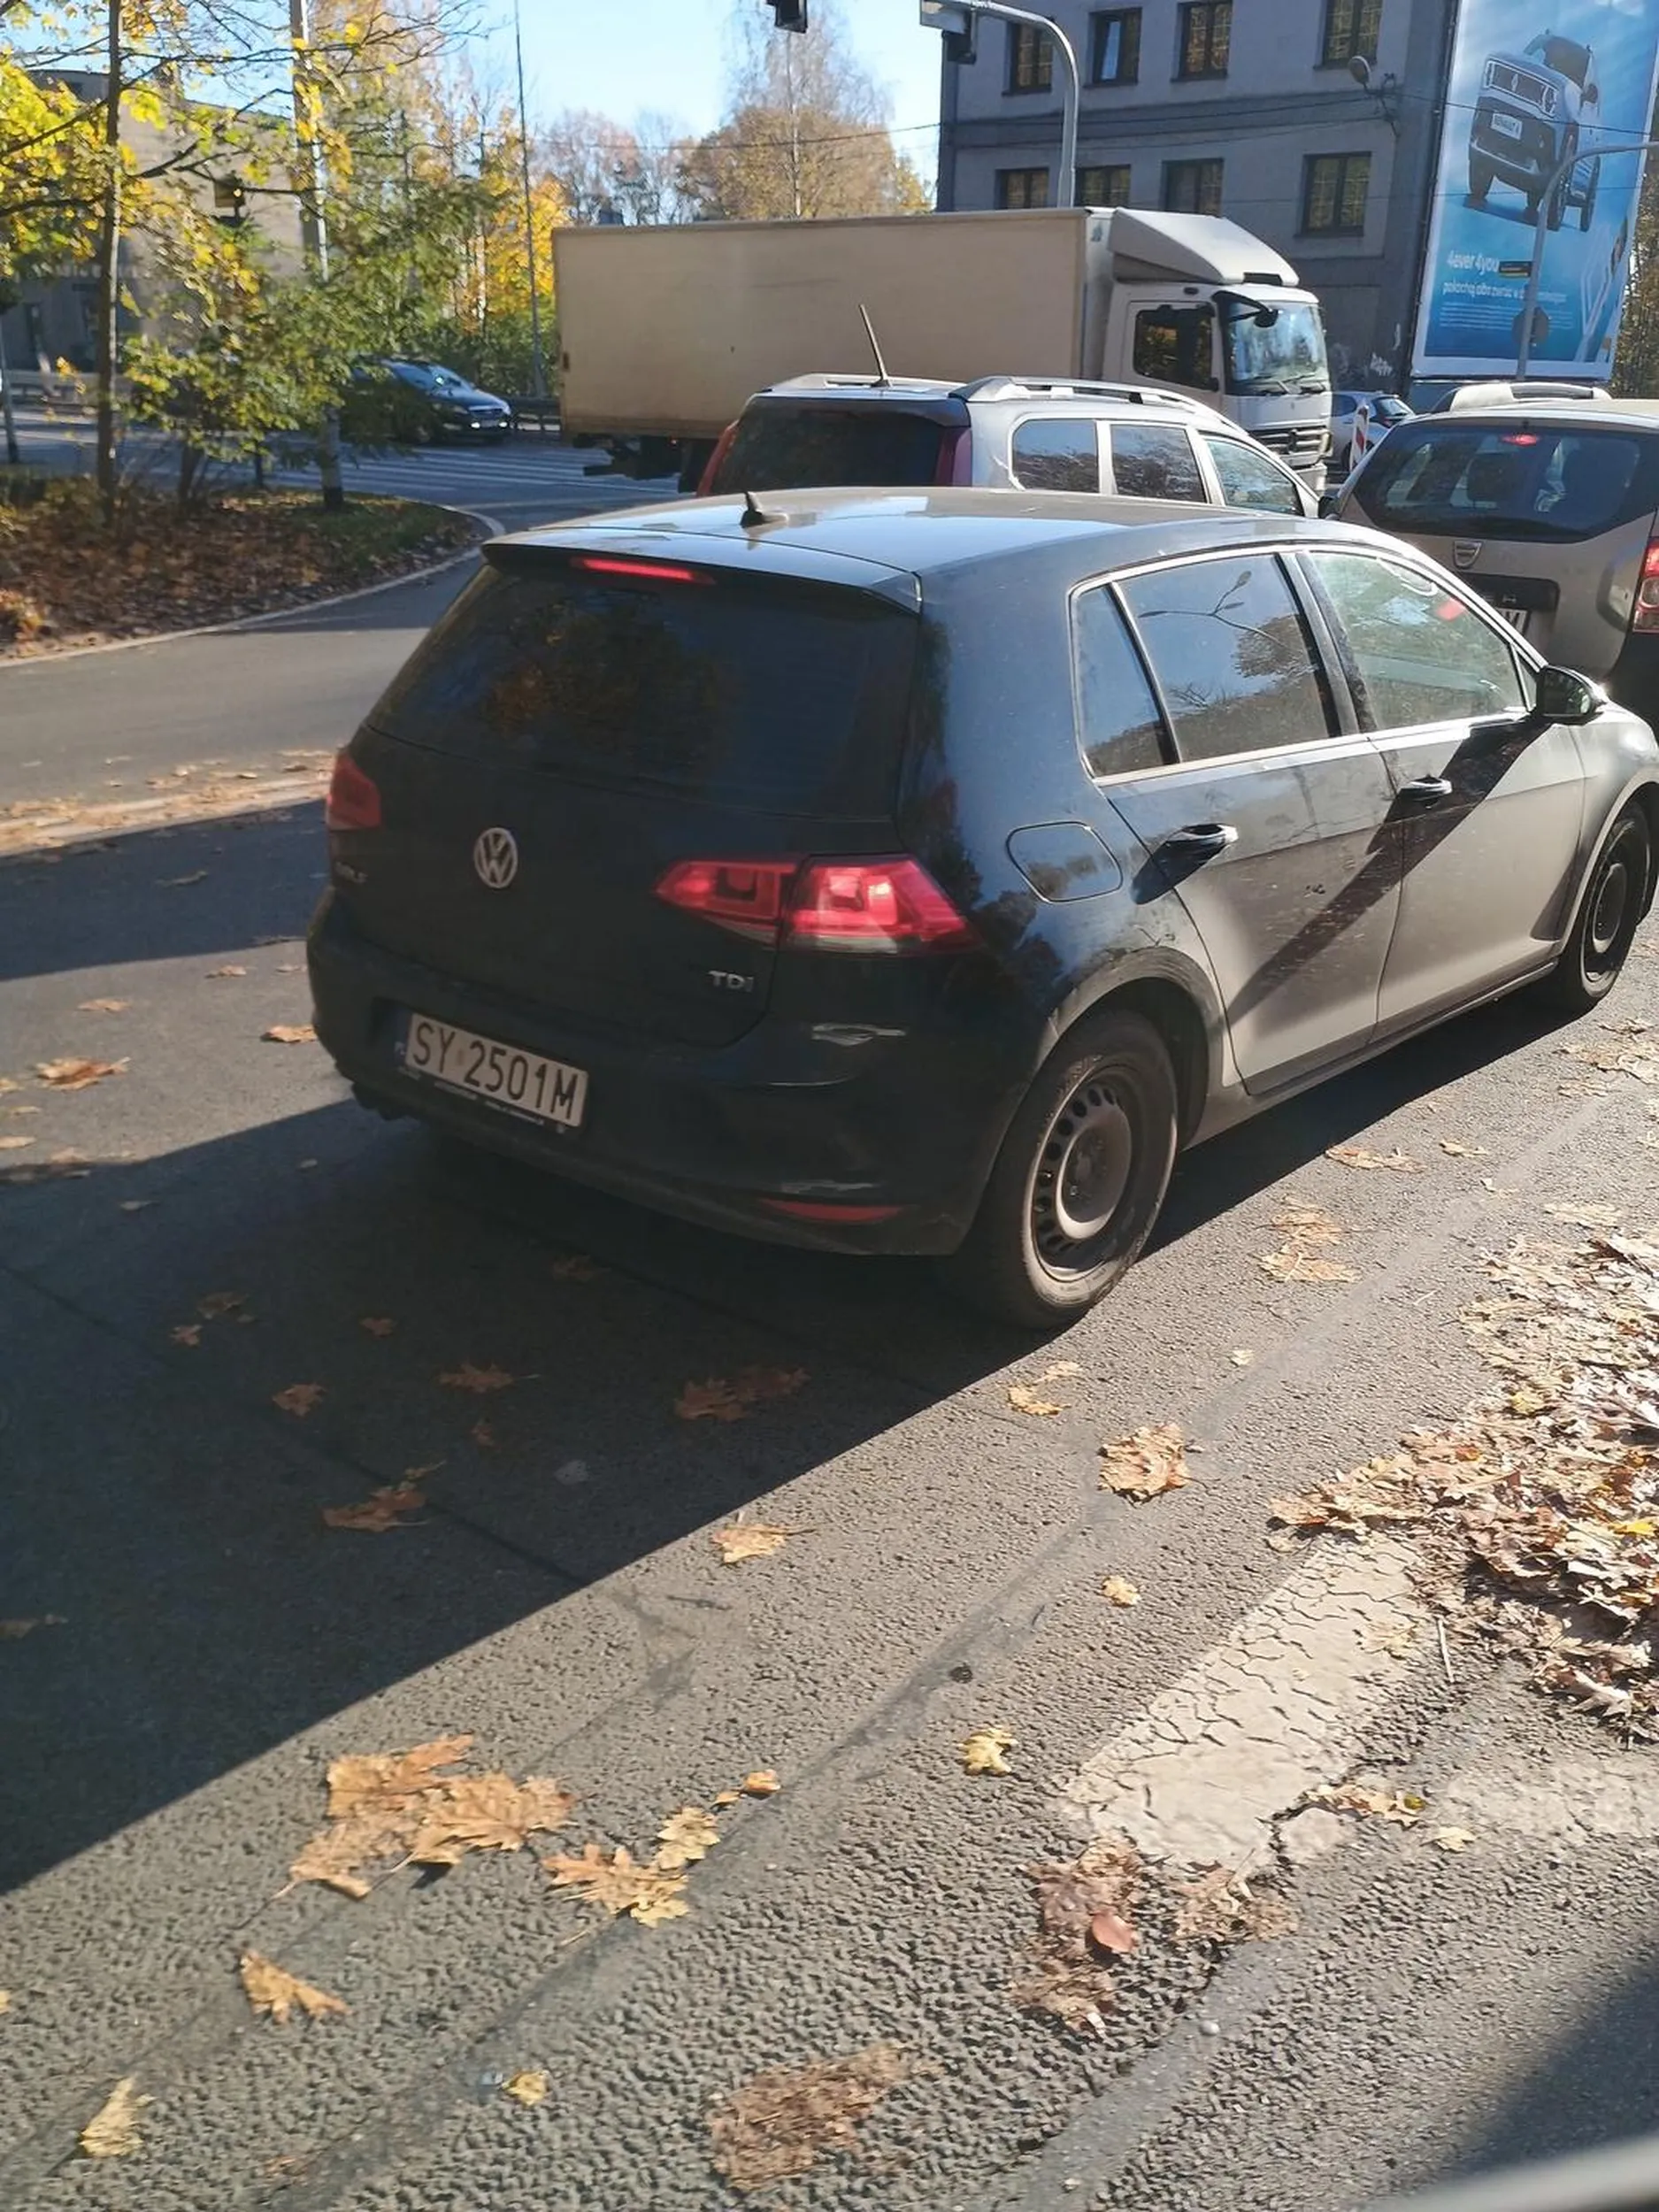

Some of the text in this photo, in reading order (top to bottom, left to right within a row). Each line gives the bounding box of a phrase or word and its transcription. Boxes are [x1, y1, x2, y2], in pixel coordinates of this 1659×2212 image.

[475, 827, 517, 887] VW
[709, 970, 753, 993] TDI
[413, 1022, 456, 1072] SY
[464, 1040, 578, 1119] 2501M
